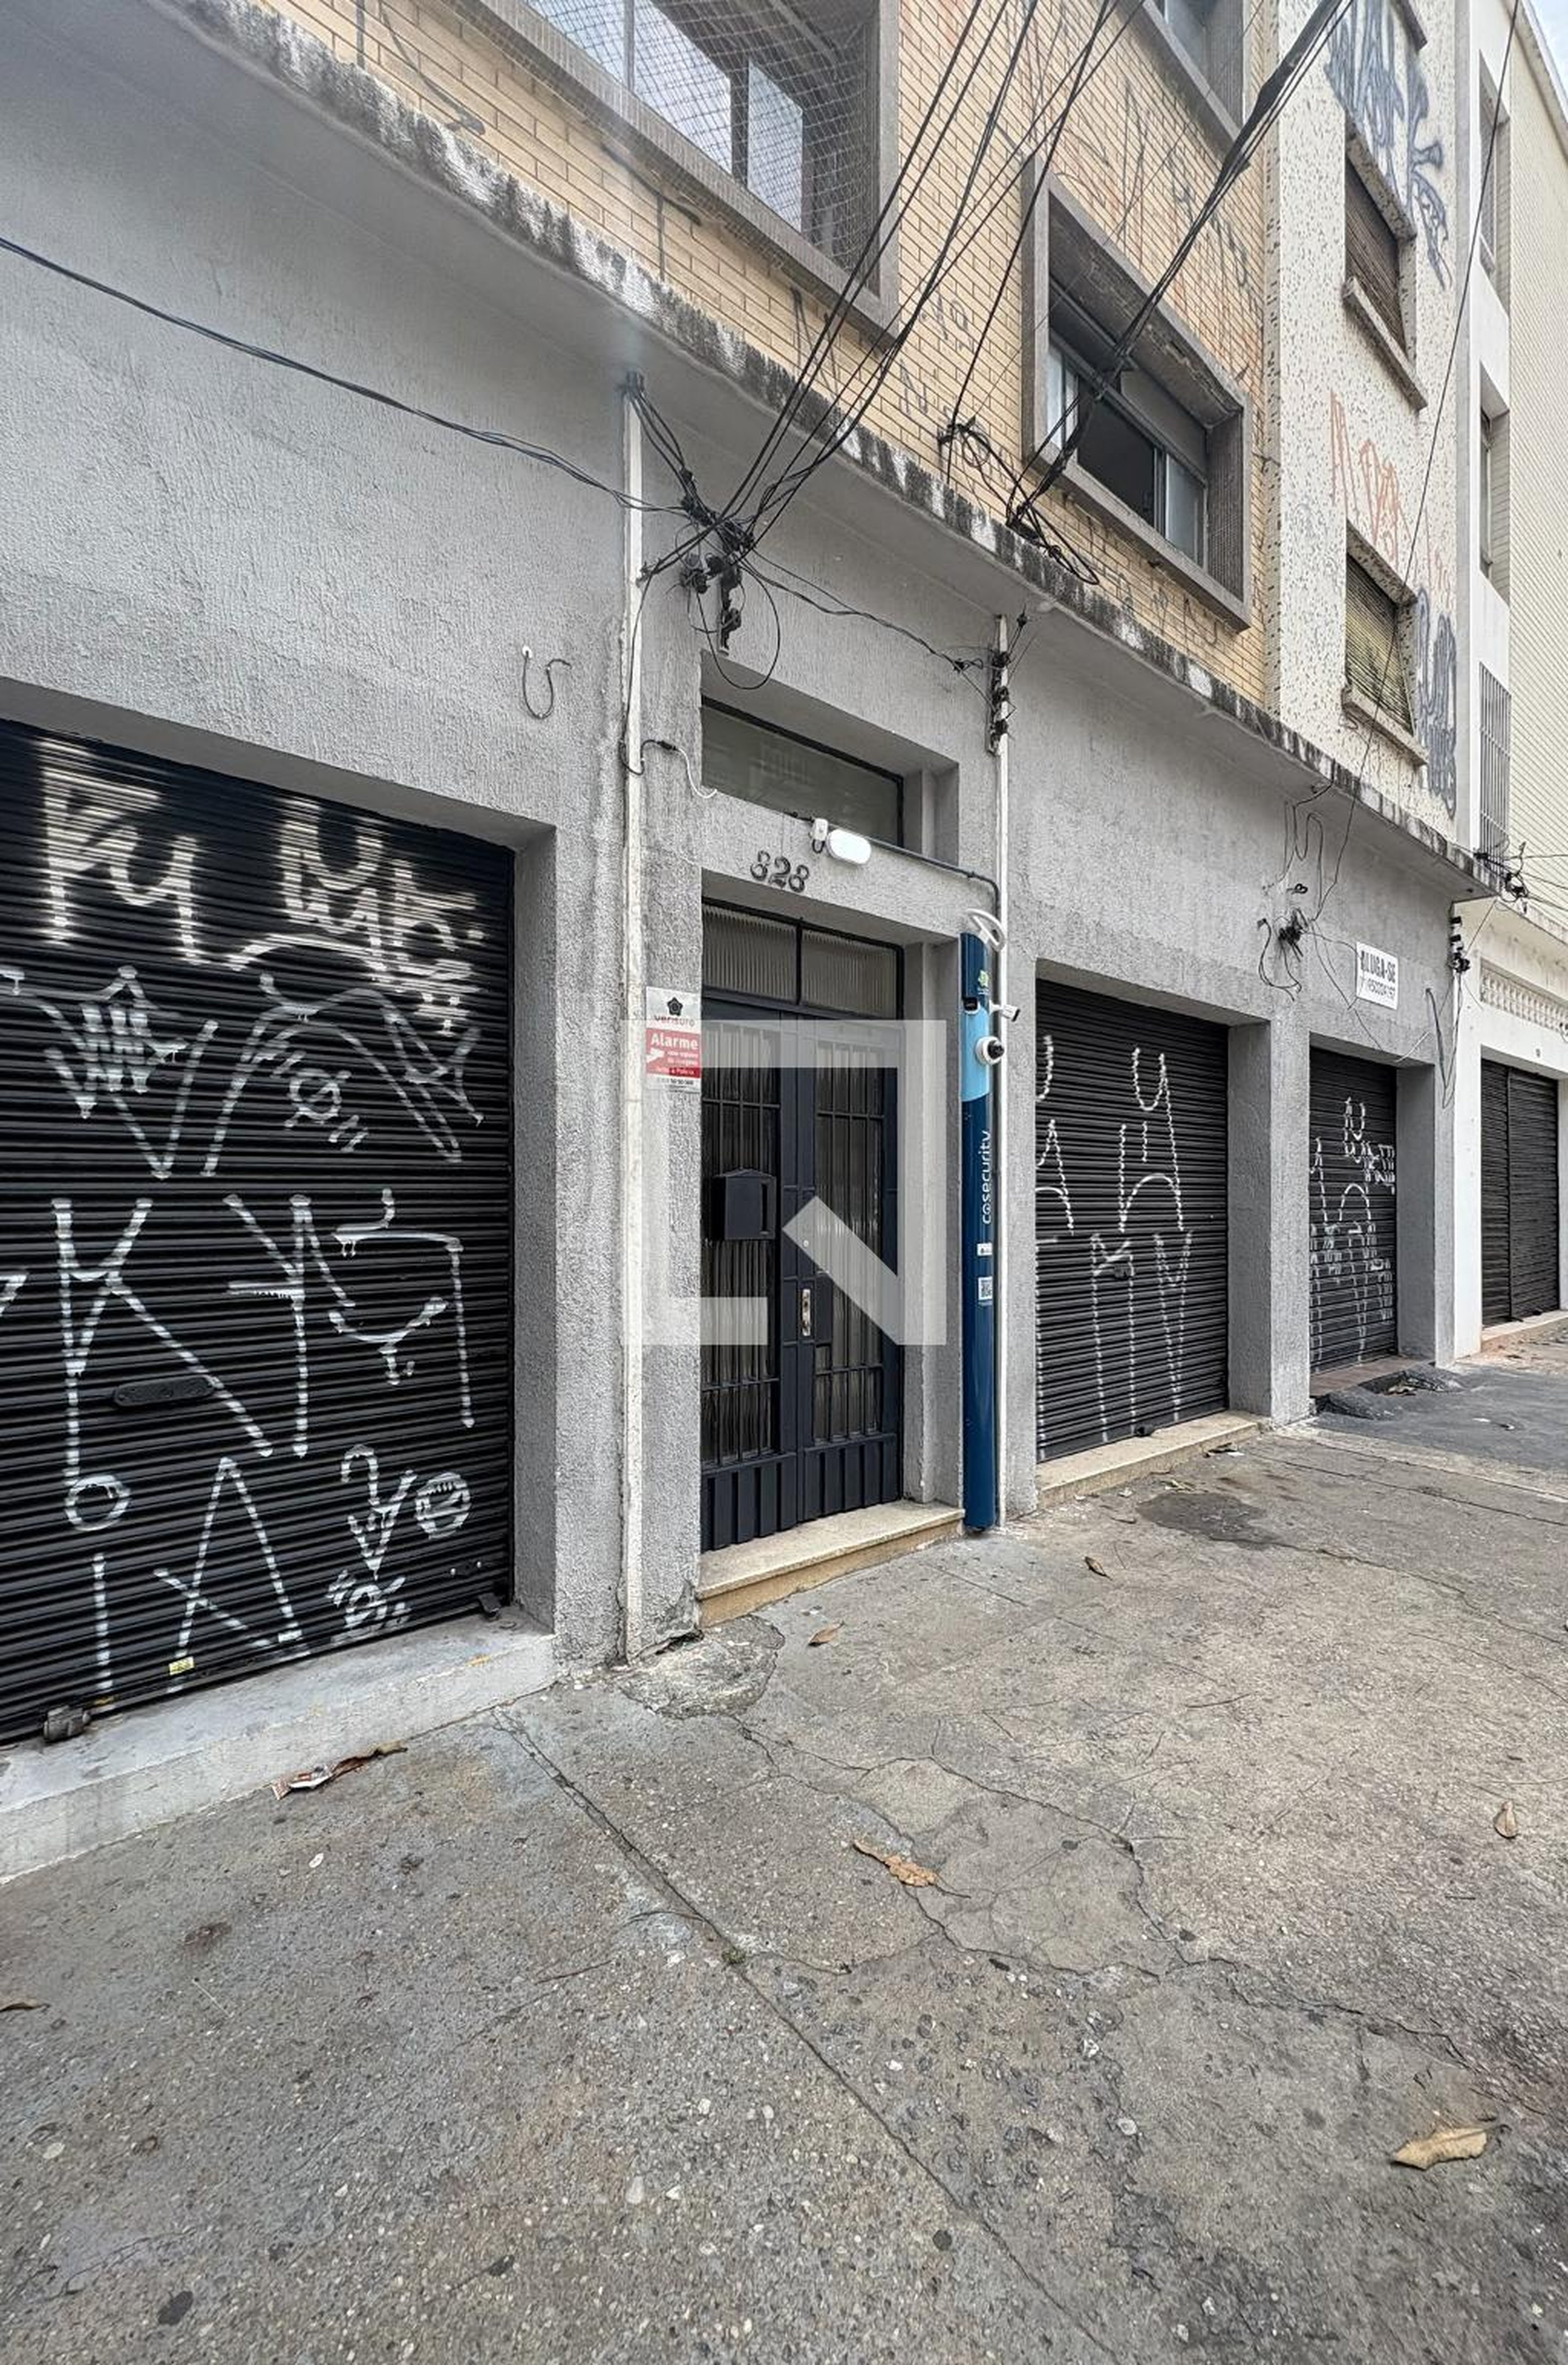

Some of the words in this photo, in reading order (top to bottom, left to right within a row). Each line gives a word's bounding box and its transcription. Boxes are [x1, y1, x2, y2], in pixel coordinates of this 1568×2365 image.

[750, 850, 810, 893] 828
[1360, 950, 1396, 984] ALUGA-SE
[654, 1014, 695, 1026] verisure
[650, 1032, 698, 1050] Alarme
